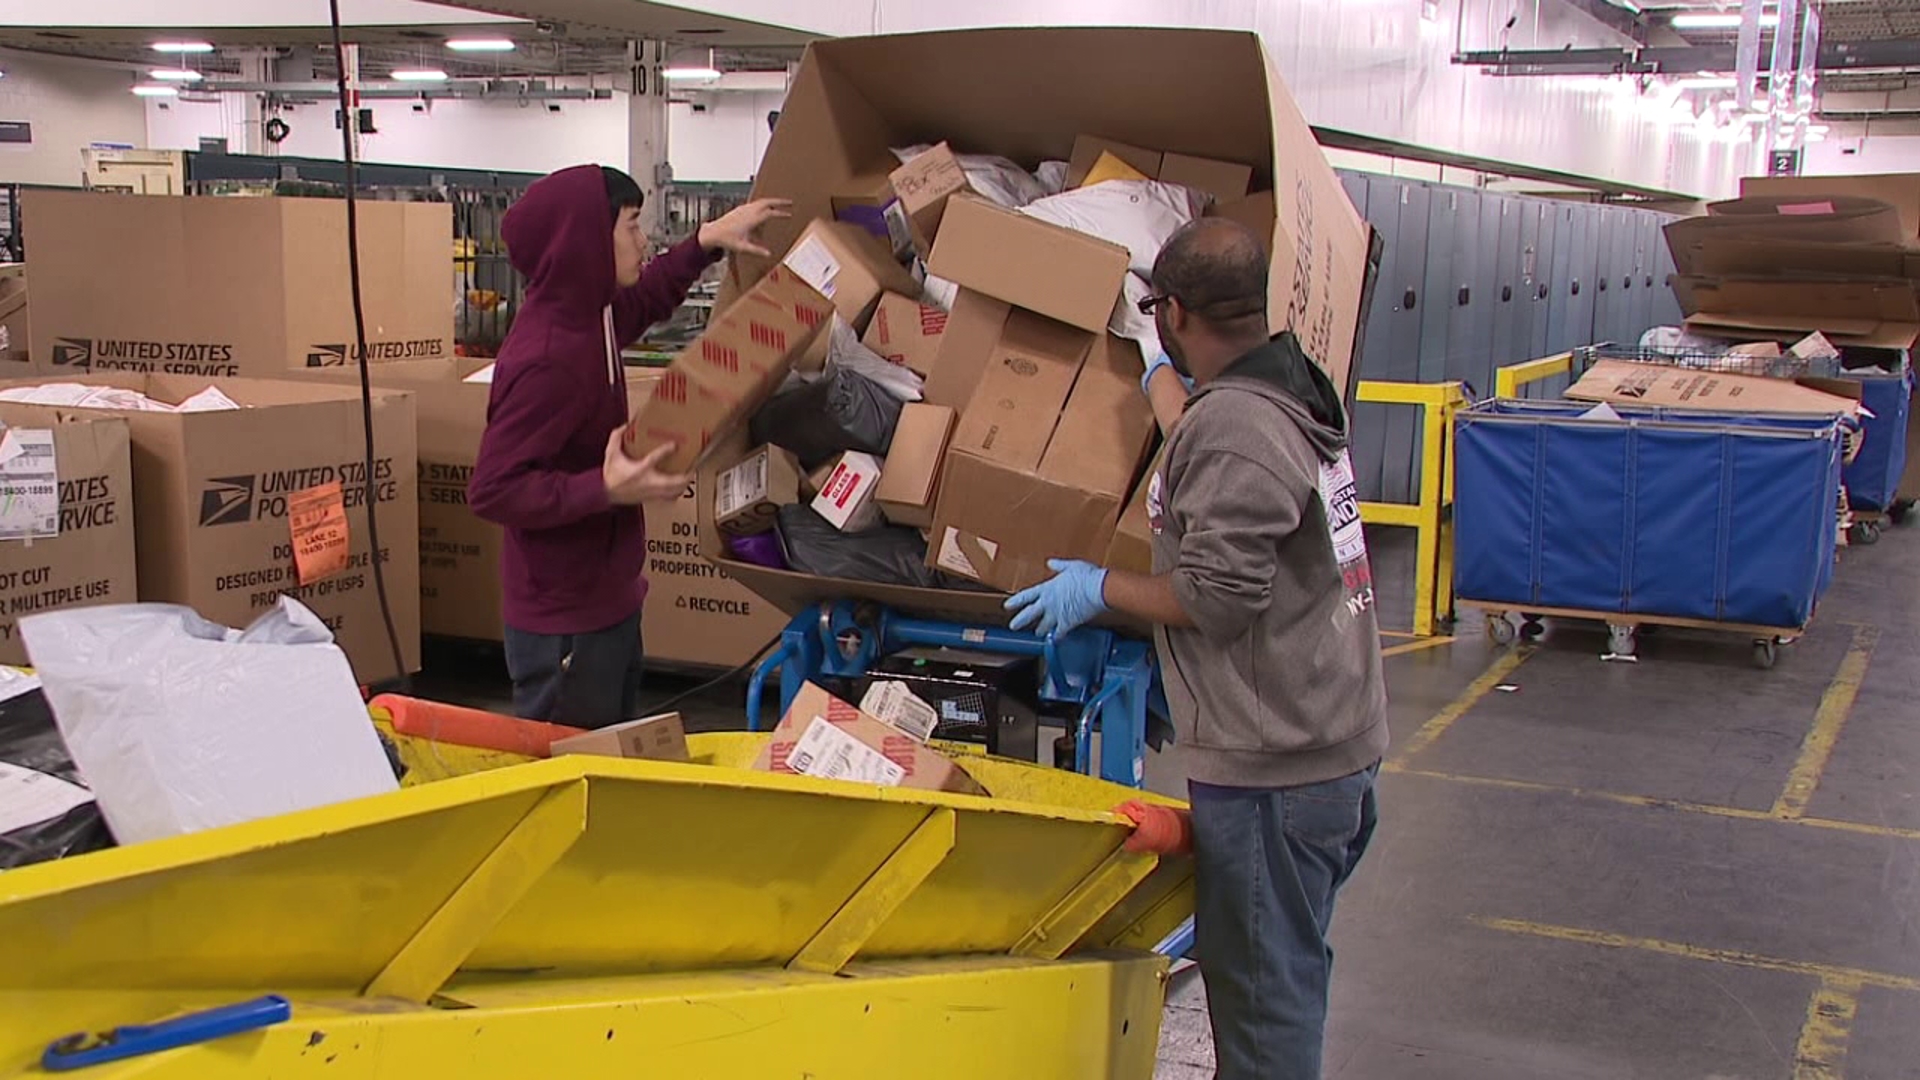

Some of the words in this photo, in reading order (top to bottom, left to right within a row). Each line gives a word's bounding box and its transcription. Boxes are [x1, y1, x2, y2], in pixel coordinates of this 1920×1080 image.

[631, 64, 646, 96] 10
[1778, 158, 1788, 170] 2
[97, 339, 164, 360] UNITED
[165, 343, 233, 362] STATES
[350, 342, 404, 360] UNITED
[405, 338, 443, 358] STATES
[261, 465, 335, 494] UNITED
[337, 457, 393, 485] STAES
[430, 463, 475, 481] STAT
[58, 475, 109, 504] TATES
[430, 487, 468, 504] SERV
[58, 501, 116, 532] RVICE
[671, 521, 691, 537] DO
[272, 544, 292, 561] DO
[647, 539, 682, 555] GNED
[685, 542, 700, 557] FO
[0, 572, 18, 591] OT
[21, 566, 51, 586] CUT
[215, 567, 284, 592] DESIGNED
[650, 558, 717, 579] PROPERTY
[10, 585, 83, 614] MULTIPLE
[86, 579, 111, 599] USE
[250, 582, 315, 608] PROPERTY
[318, 581, 334, 596] OF
[336, 573, 365, 592] USPS
[689, 595, 751, 616] RECYCLE
